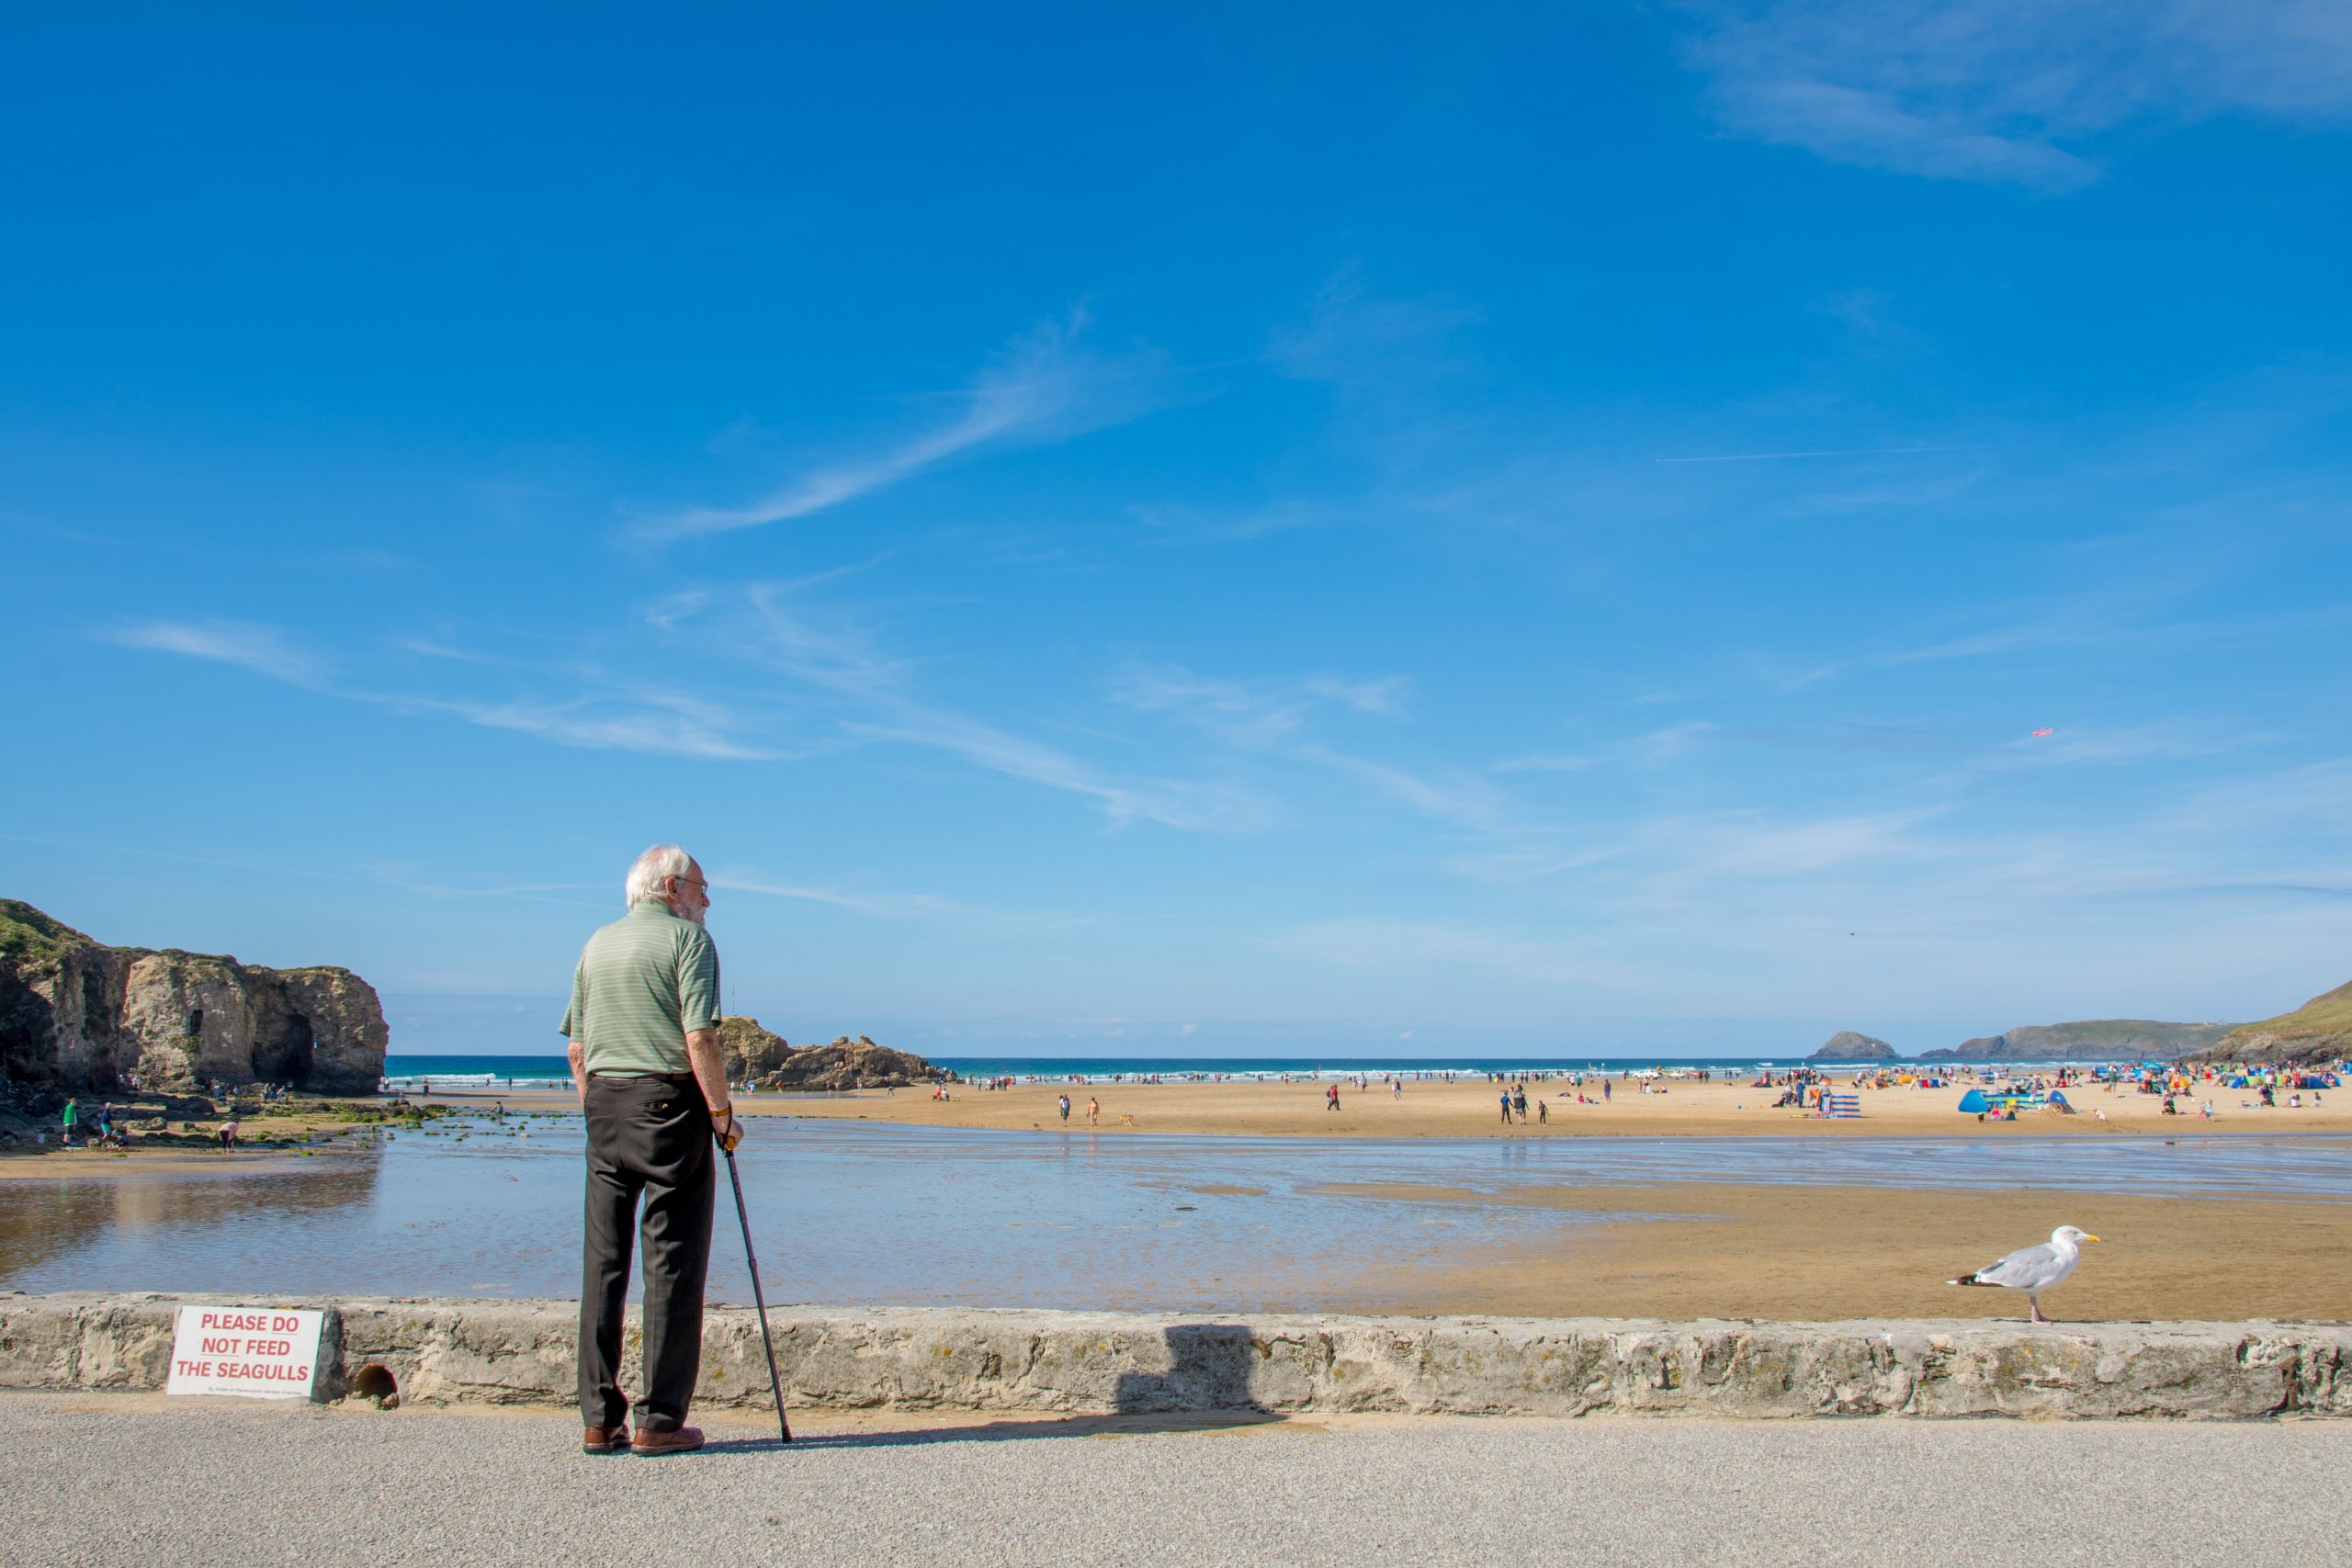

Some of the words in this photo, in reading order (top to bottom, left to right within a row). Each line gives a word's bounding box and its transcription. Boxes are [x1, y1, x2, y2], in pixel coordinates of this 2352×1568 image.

[200, 1314, 267, 1331] PLEASE
[272, 1316, 300, 1332] DO
[201, 1337, 242, 1354] NOT
[245, 1339, 291, 1356] FEED
[176, 1360, 212, 1377] THE
[216, 1362, 309, 1382] SEAGULLS
